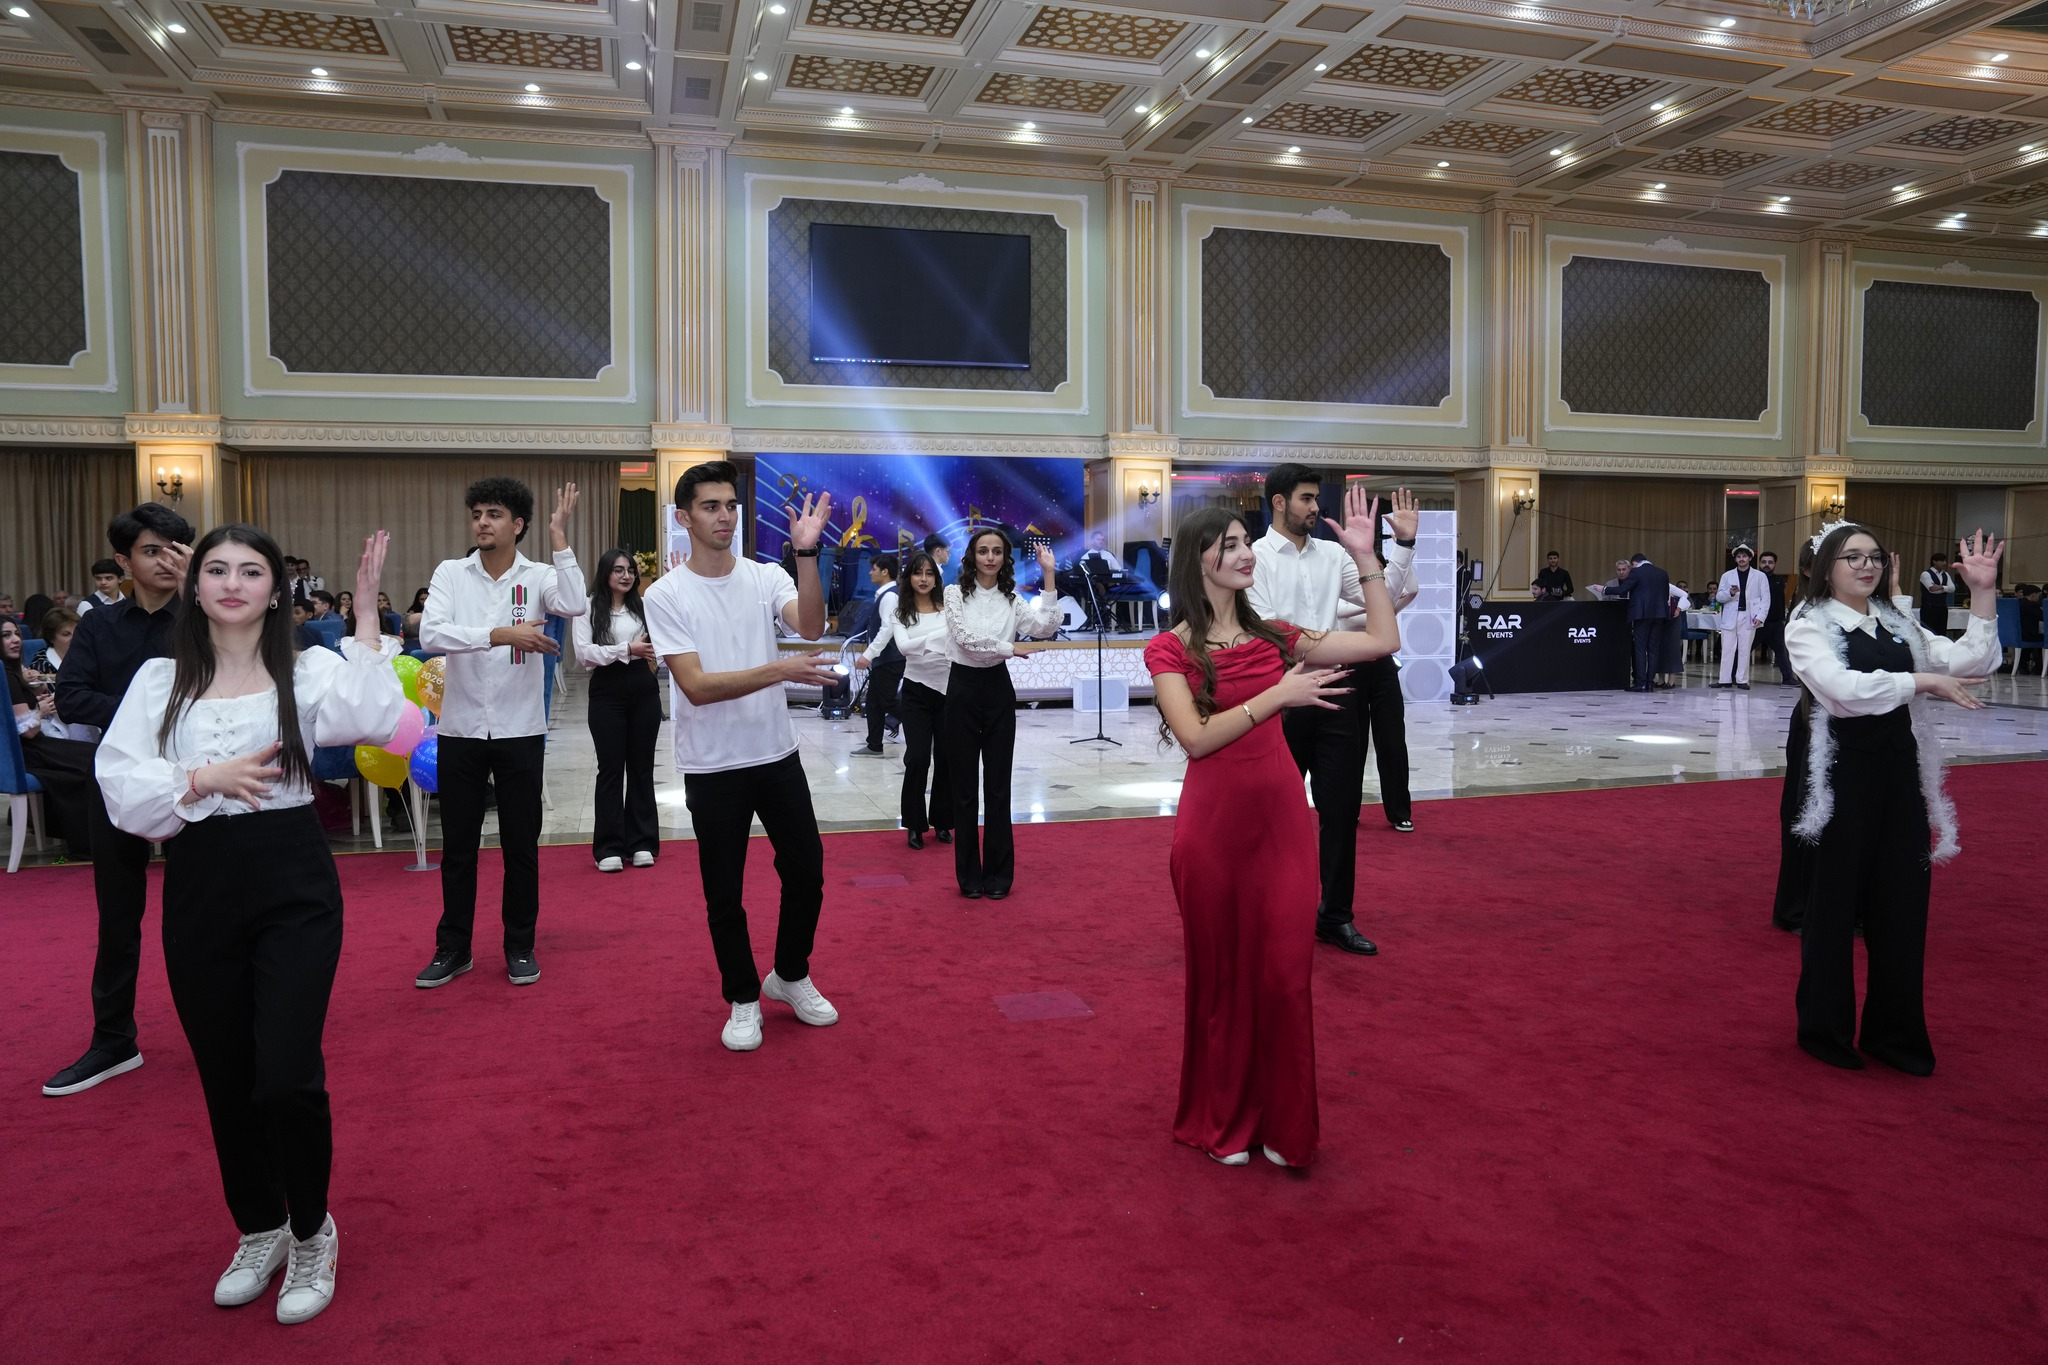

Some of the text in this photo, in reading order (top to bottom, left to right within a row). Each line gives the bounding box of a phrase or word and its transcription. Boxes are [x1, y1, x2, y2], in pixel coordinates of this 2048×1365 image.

[1478, 614, 1522, 630] RAR
[1487, 631, 1513, 639] EVENTS
[1568, 627, 1597, 638] RAR
